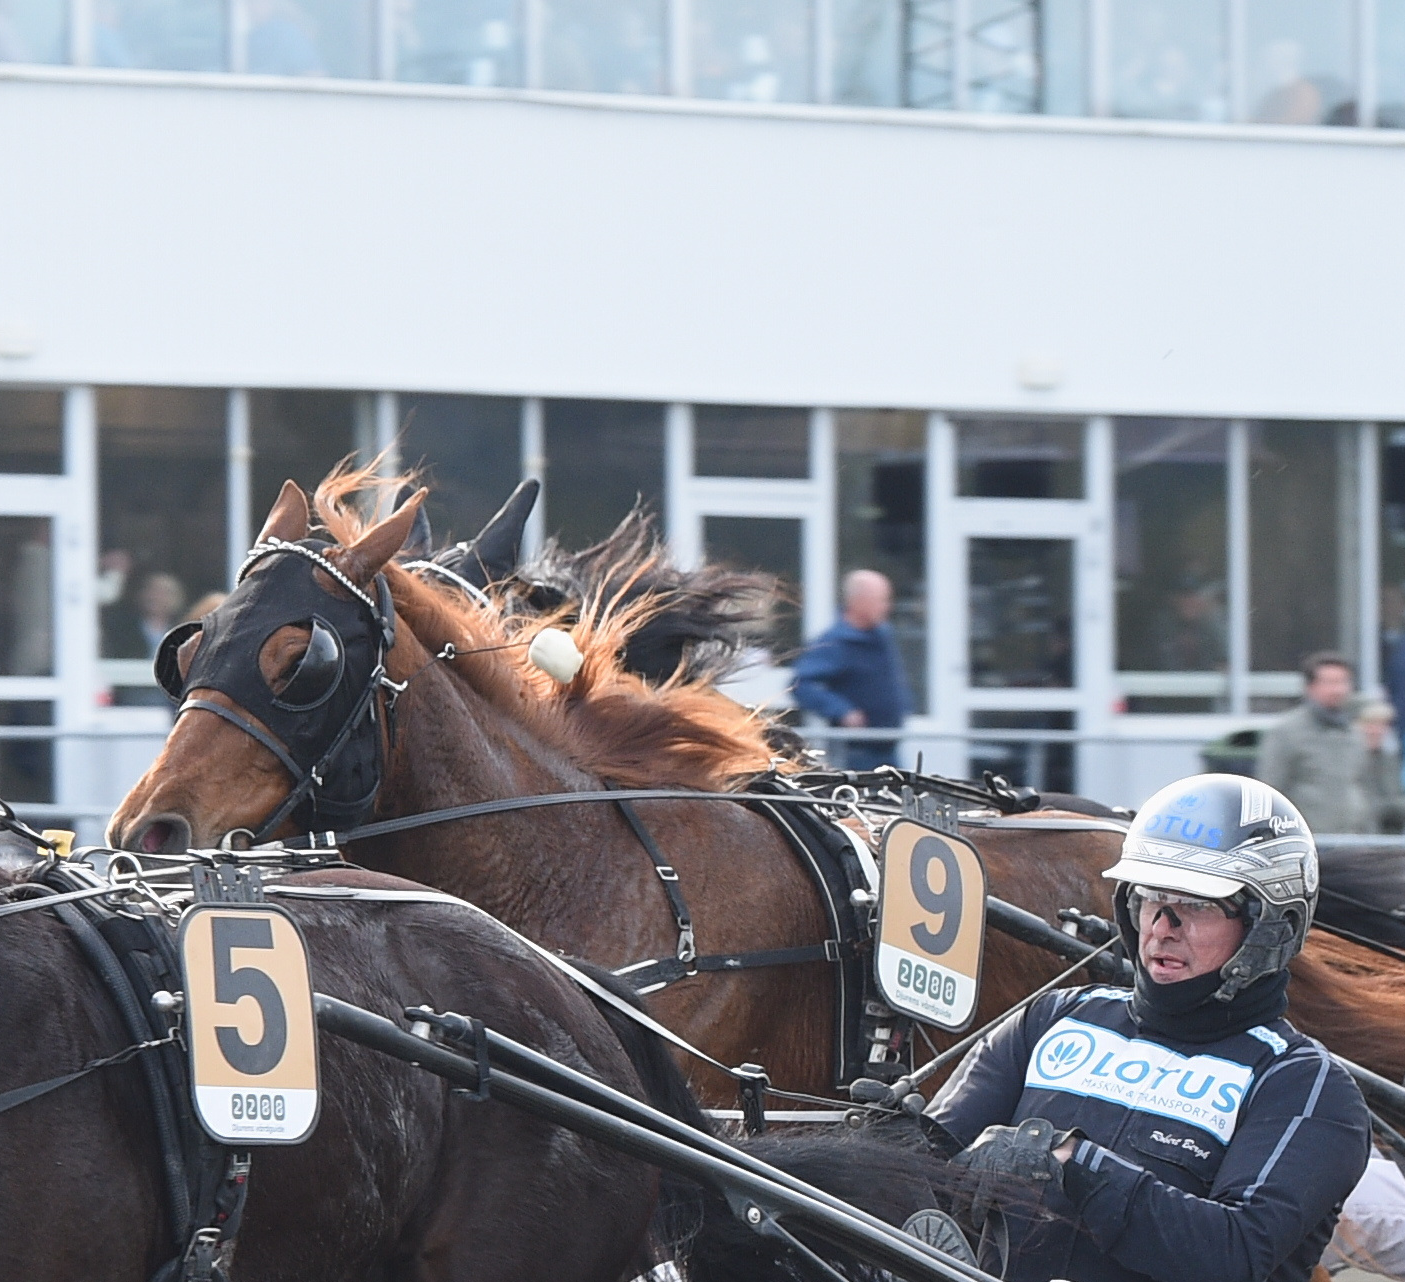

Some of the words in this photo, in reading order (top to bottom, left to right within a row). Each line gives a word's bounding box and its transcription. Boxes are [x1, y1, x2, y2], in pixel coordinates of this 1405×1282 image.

[910, 836, 963, 955] 9
[210, 917, 288, 1075] 5
[899, 960, 955, 1003] 2288
[232, 1096, 284, 1119] 2288
[1081, 1078, 1125, 1094] MASKIN
[1126, 1090, 1133, 1098] &
[1138, 1092, 1209, 1119] TRANSPORT
[1209, 1116, 1227, 1130] AB
[1090, 1052, 1242, 1113] LOTUS
